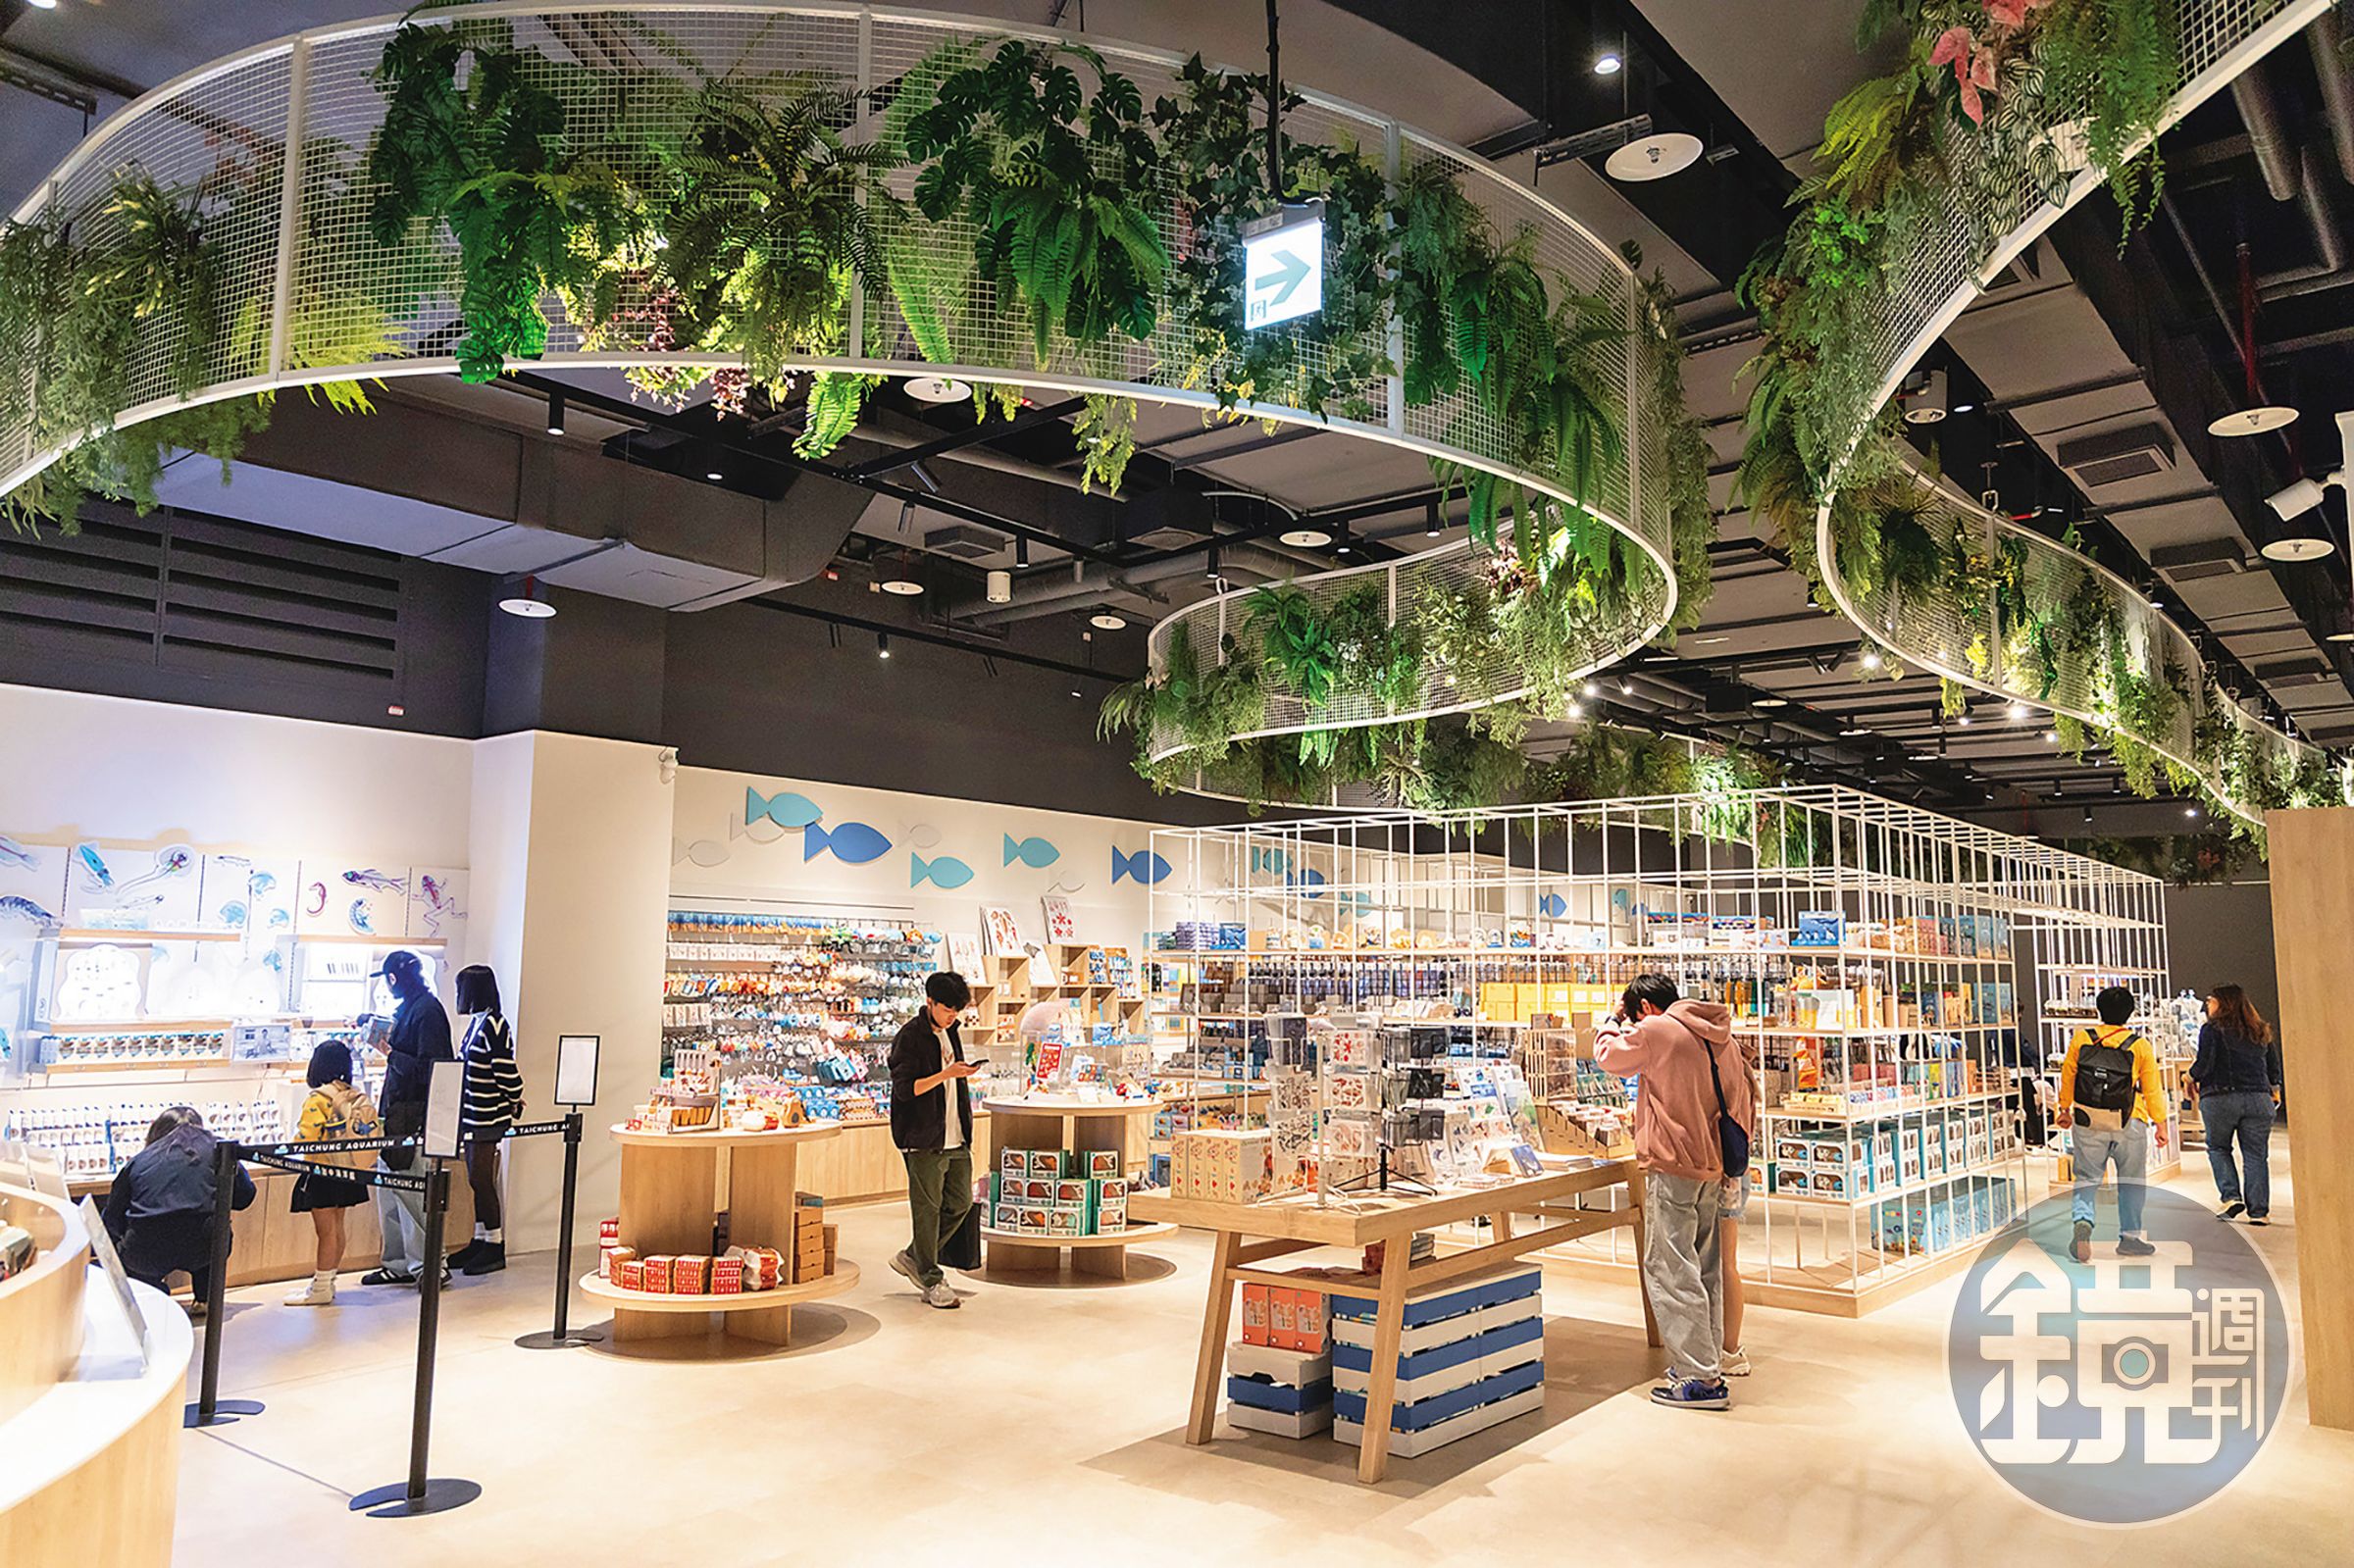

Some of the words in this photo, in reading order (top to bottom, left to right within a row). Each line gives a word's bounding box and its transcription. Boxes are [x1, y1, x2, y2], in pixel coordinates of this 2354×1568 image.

[519, 1124, 558, 1135] TAICHUNG
[293, 1141, 341, 1153] TAICHUNG
[345, 1138, 394, 1151] AQUARIUM
[384, 1176, 413, 1189] TAICHUNG
